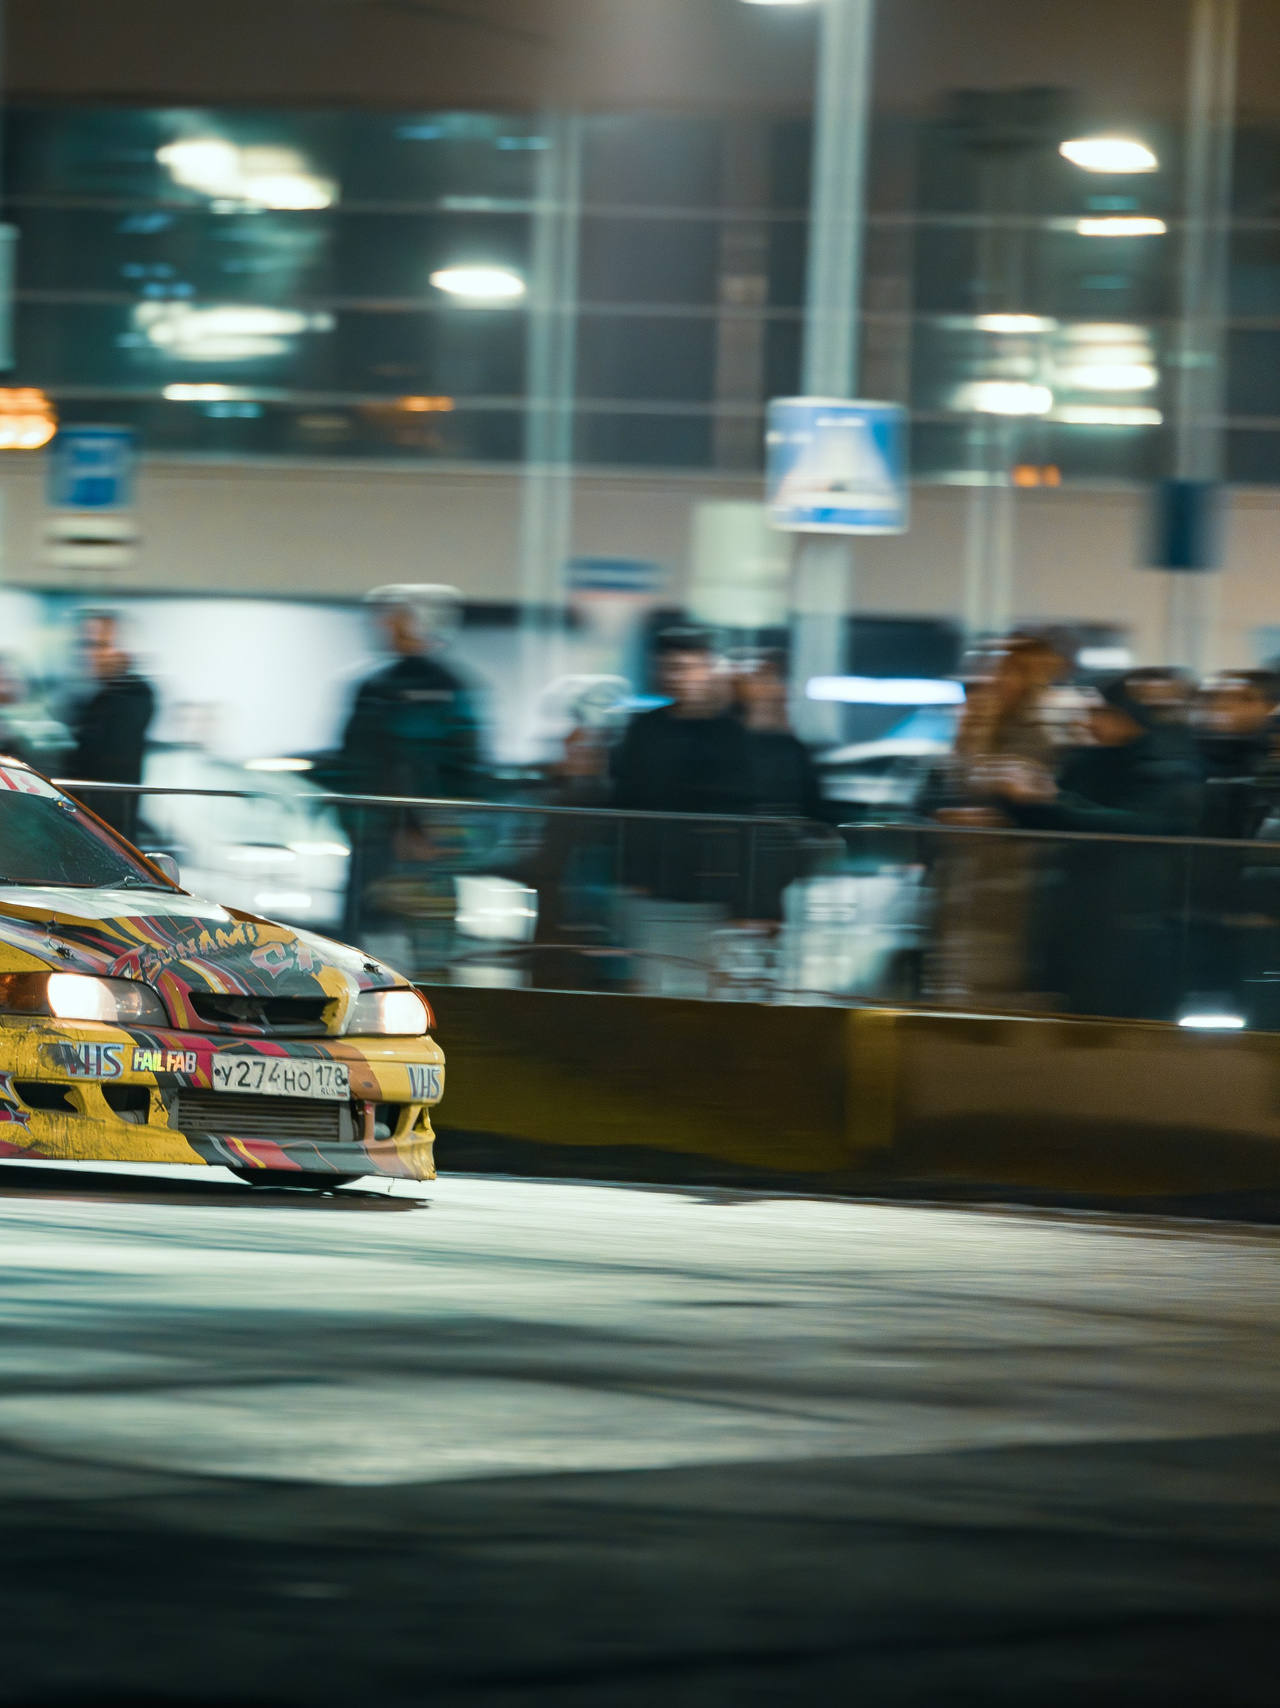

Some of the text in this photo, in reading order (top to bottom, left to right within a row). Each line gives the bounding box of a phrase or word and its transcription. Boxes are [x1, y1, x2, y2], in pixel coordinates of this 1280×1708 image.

[60, 1041, 123, 1078] VHS
[315, 1065, 343, 1086] 178
[407, 1065, 440, 1099] VHS
